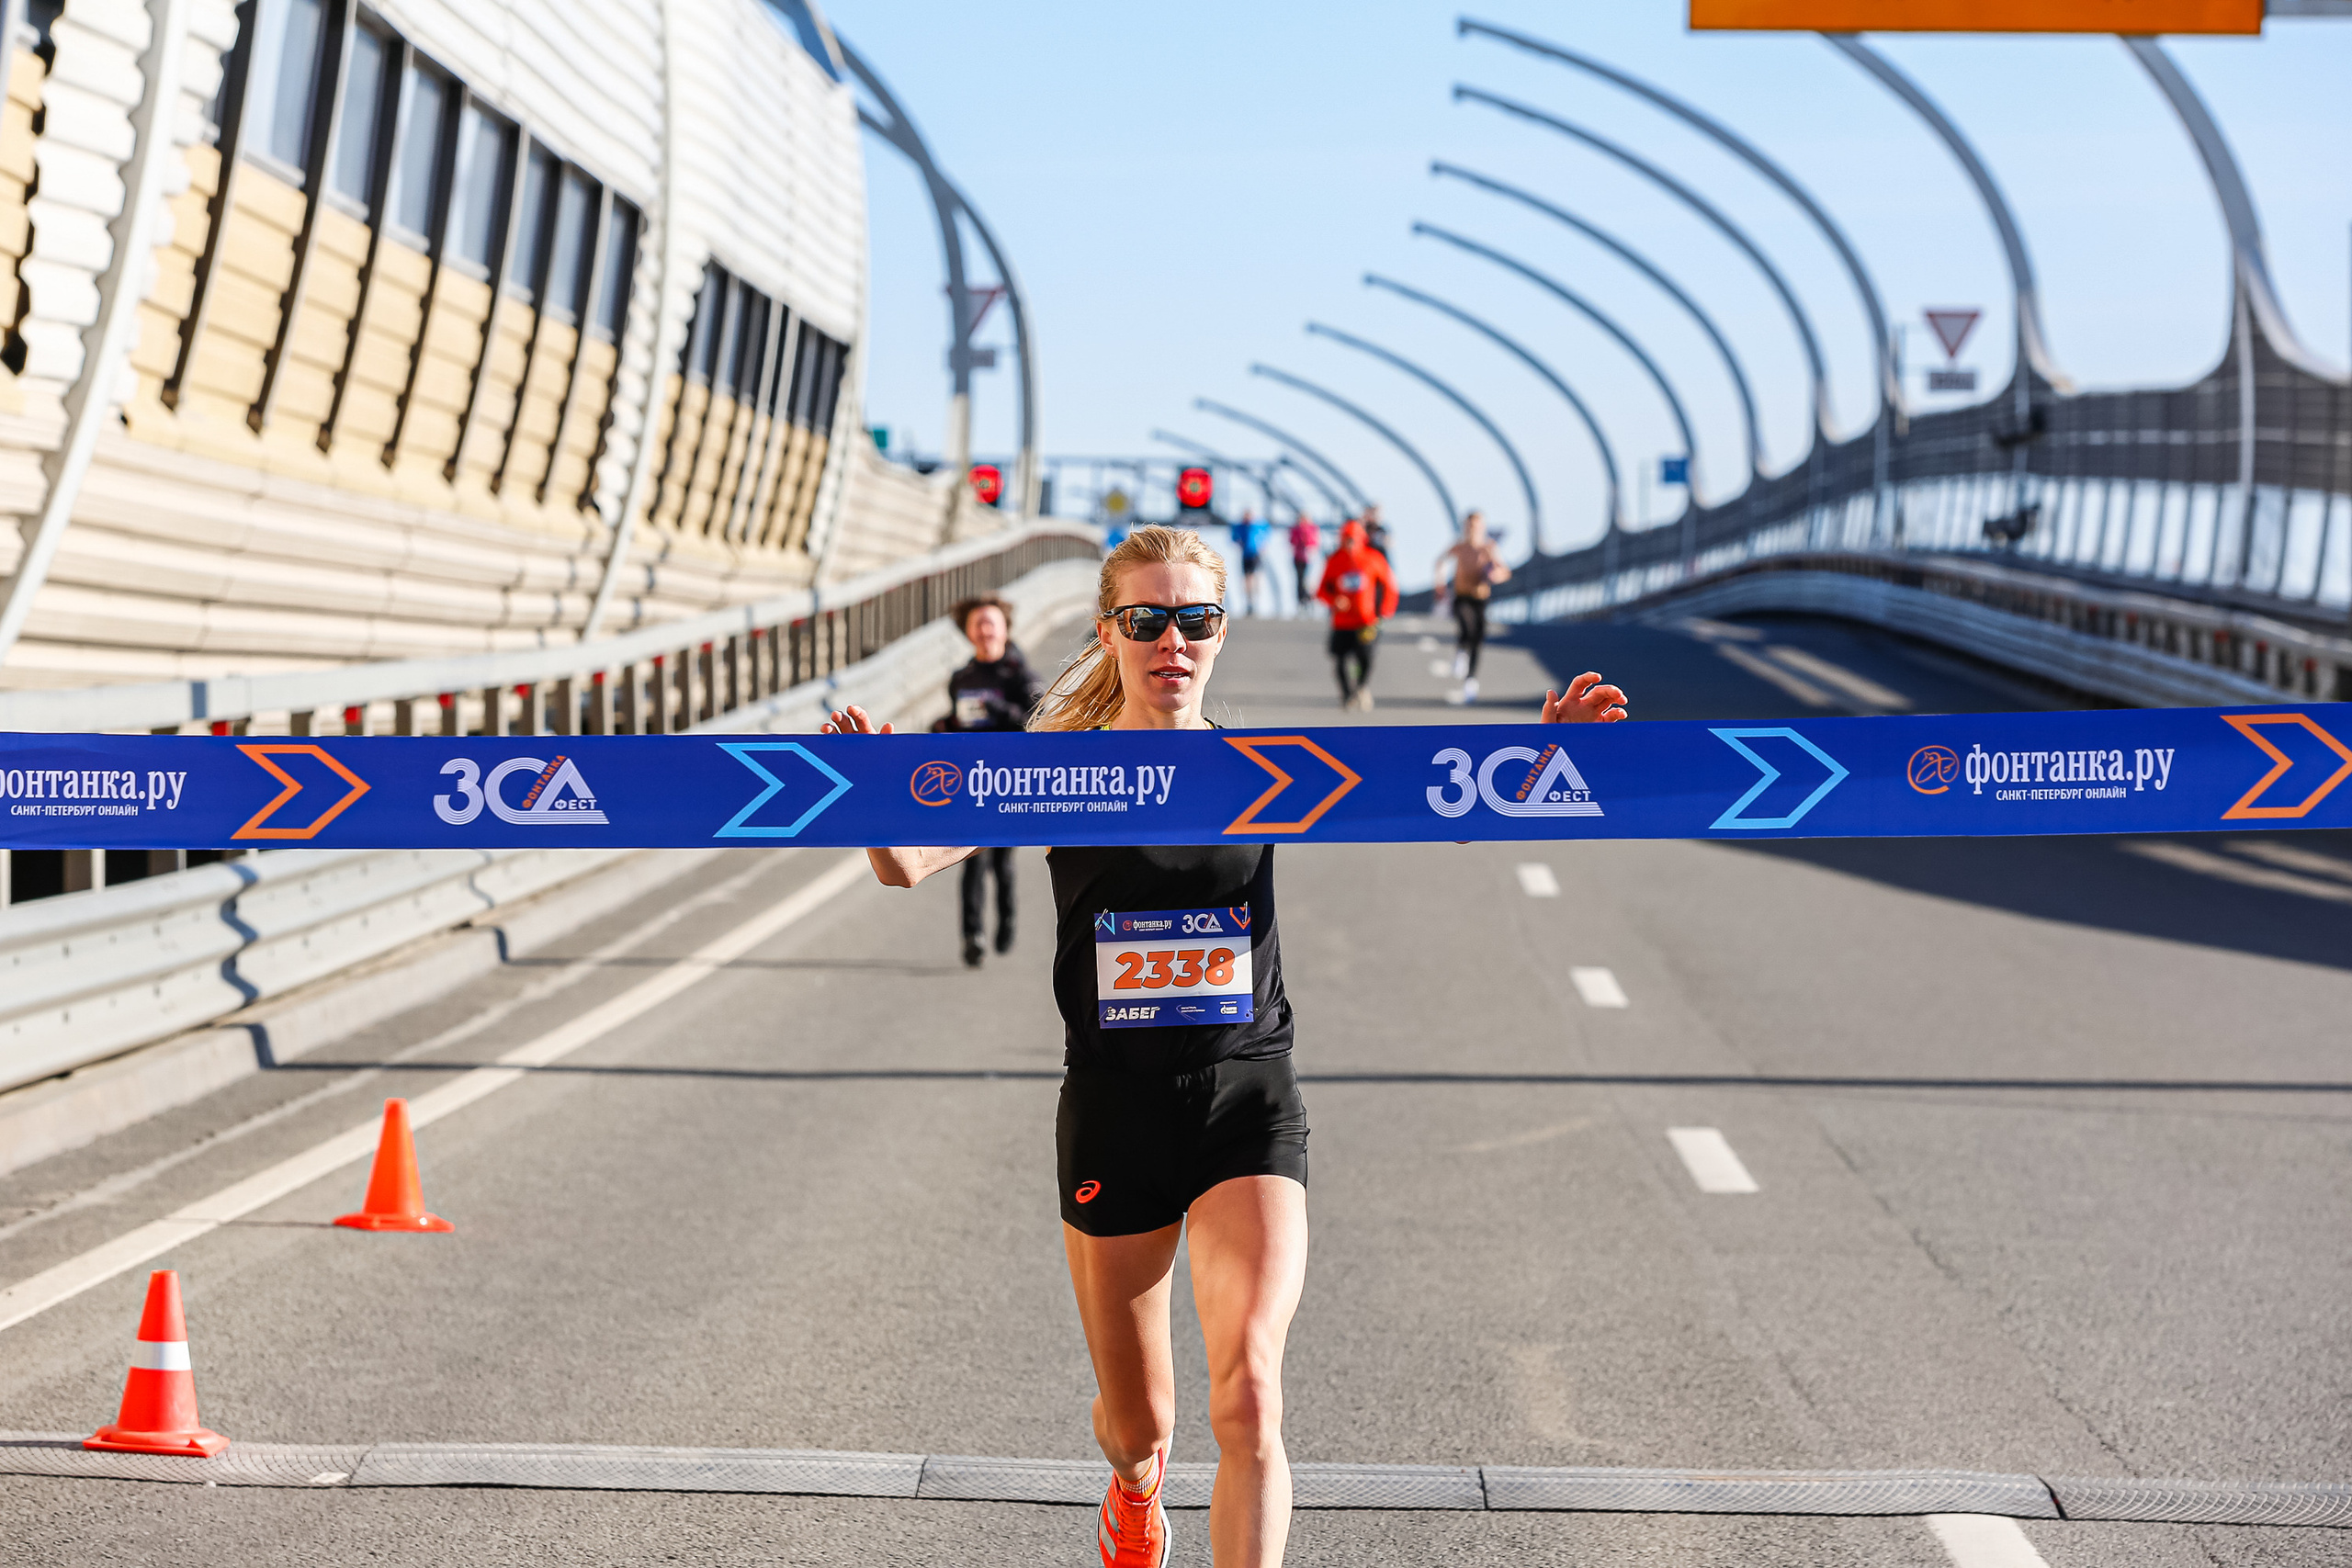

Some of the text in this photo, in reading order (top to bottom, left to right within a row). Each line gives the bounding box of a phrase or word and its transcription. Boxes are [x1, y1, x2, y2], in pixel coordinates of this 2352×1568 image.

[1516, 743, 1559, 800] ФОНТАНКА
[1965, 743, 2175, 795] фонтанка.ру
[522, 754, 567, 808] ФОНТАНКА
[967, 760, 1176, 807] фонтанка.ру
[1548, 790, 1591, 802] ФЕСТ
[1996, 785, 2127, 801] САНКТ-ПЕТЕРБУРГ ОНЛАЙН
[10, 804, 139, 816] САНКТ-ПЕТЕРБУРГ ОНЛАЙН
[554, 799, 597, 810] ФЕСТ
[999, 800, 1128, 814] САНКТ-ПЕТЕРБУРГ ОНЛАЙН
[1133, 919, 1172, 931] фонтанка.ру
[1114, 947, 1236, 989] 2338
[1105, 1006, 1160, 1021] ЗАБЕГ
